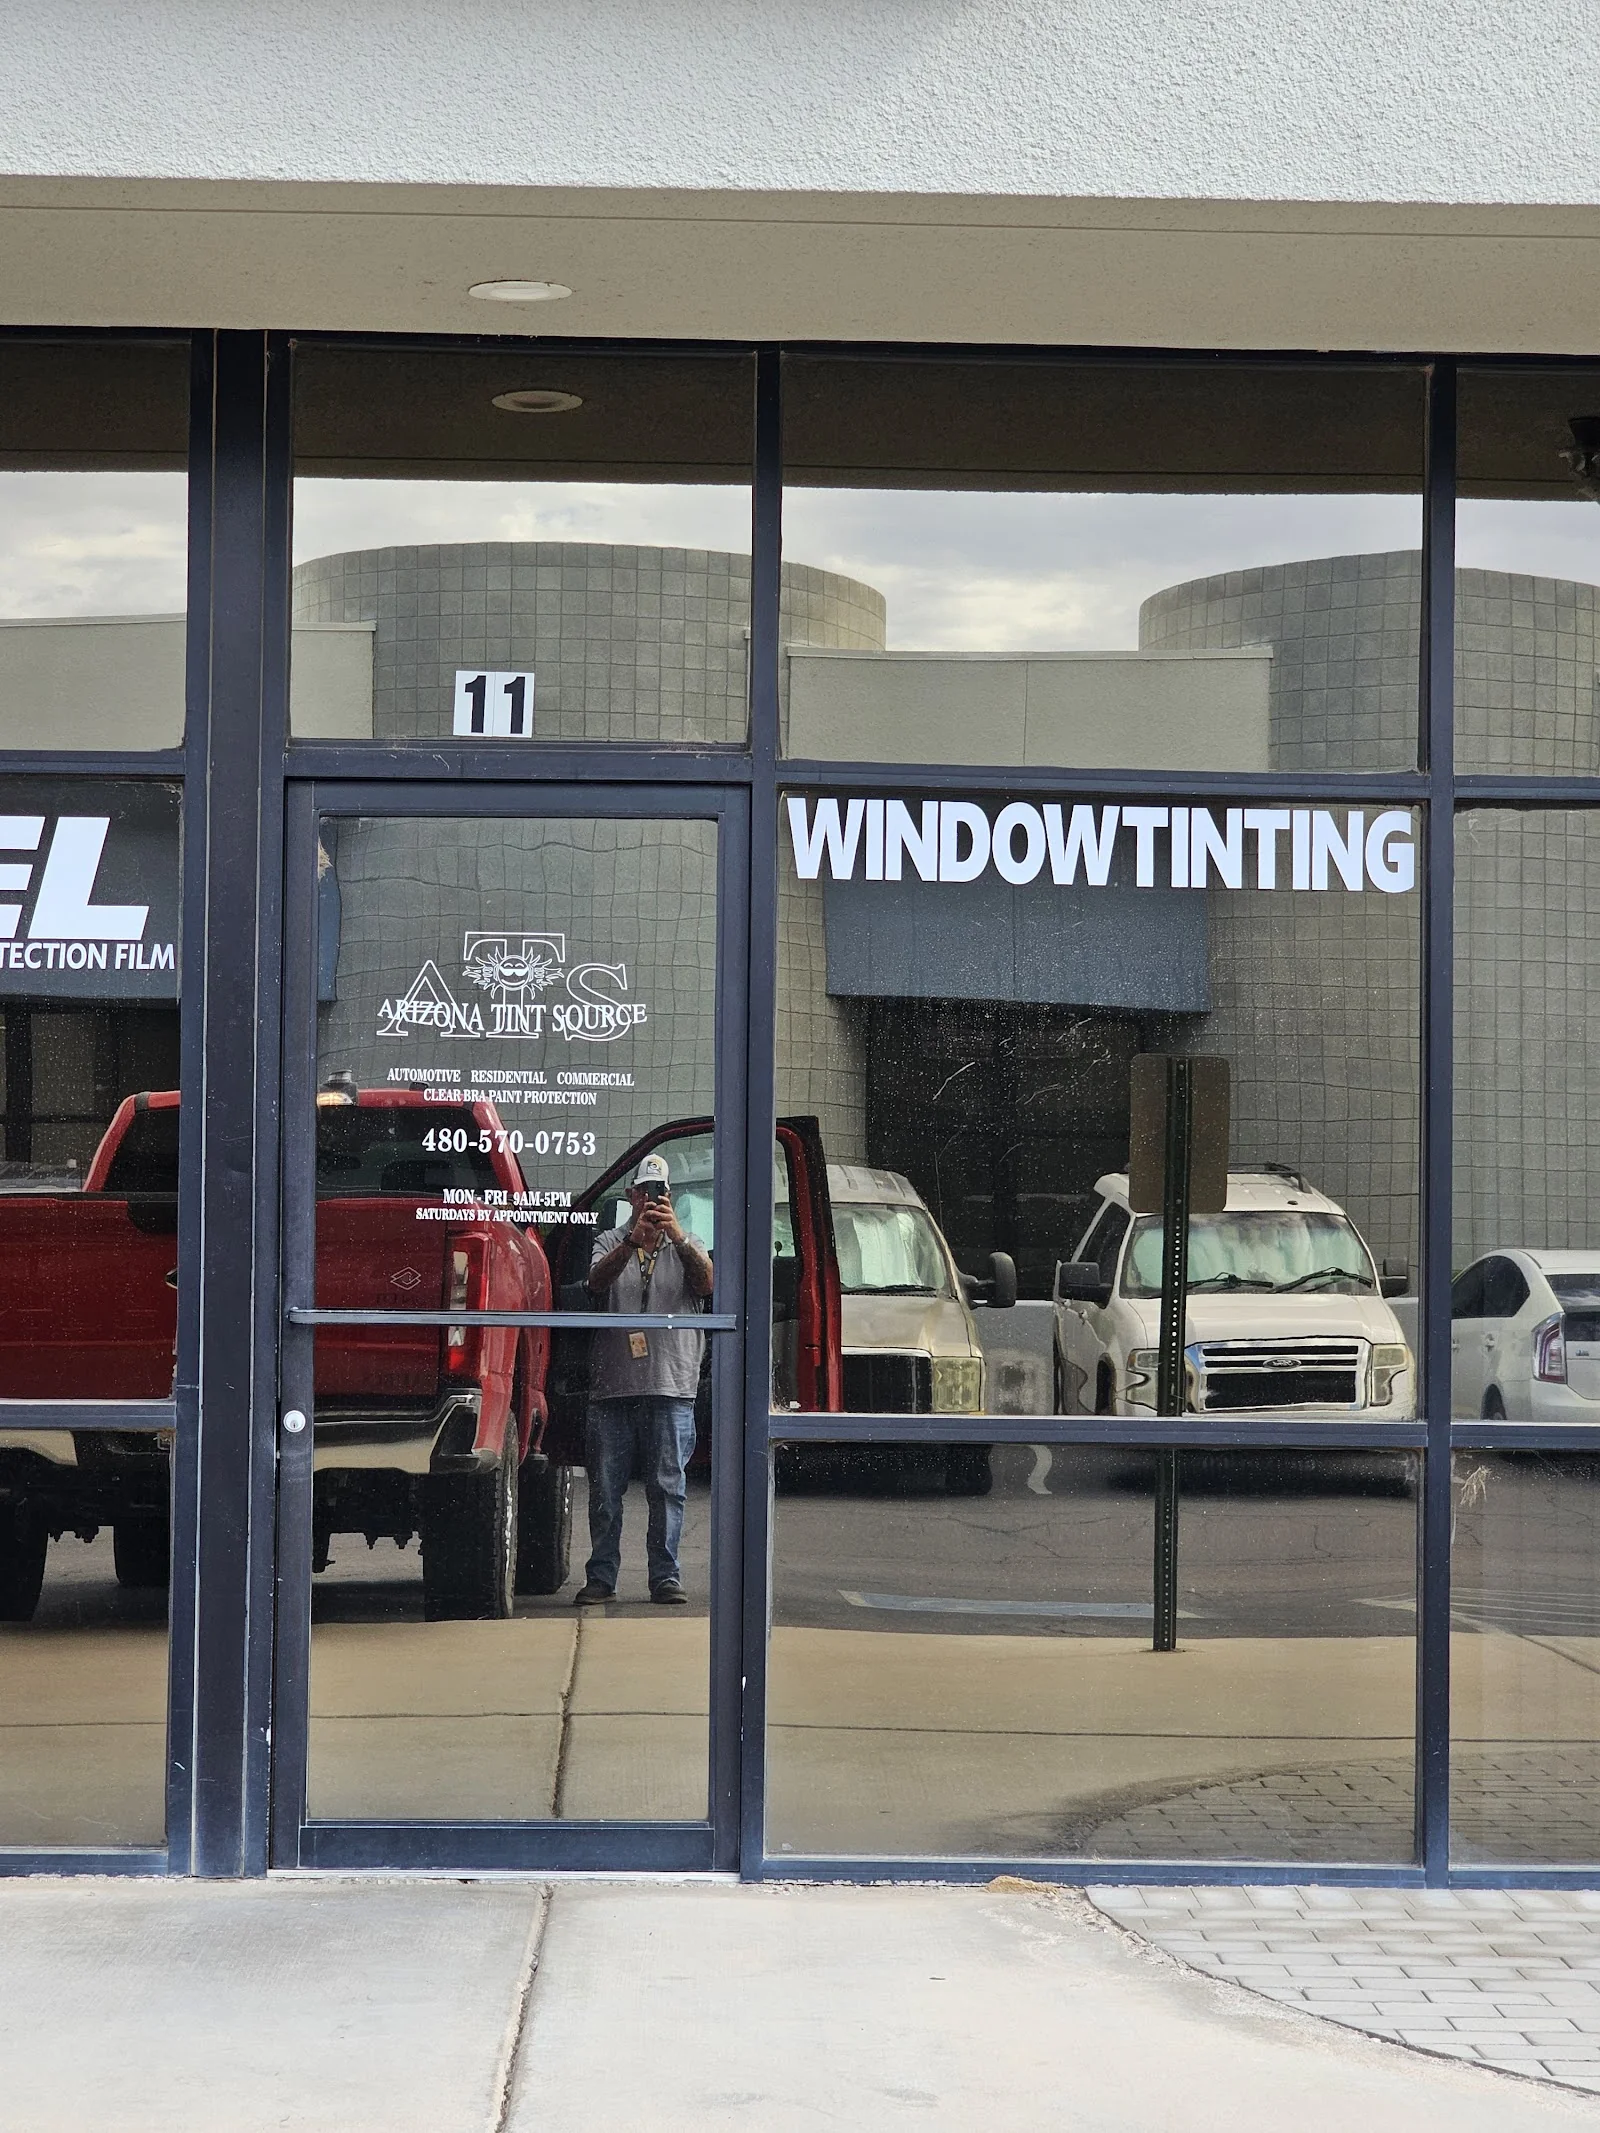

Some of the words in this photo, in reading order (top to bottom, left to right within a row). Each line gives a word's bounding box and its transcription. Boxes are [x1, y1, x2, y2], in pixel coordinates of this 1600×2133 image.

[464, 675, 526, 734] 11
[0, 942, 108, 969] TECTION
[114, 943, 175, 970] FILM
[376, 998, 485, 1031] ARIZONA
[490, 1004, 547, 1033] TINT
[551, 1003, 648, 1032] SOURCE
[386, 1067, 461, 1083] AUTOMOTIVE
[470, 1069, 548, 1085] RESIDENTIAL
[556, 1071, 635, 1087] COMMERCIAL
[423, 1088, 462, 1102] CLEAR
[463, 1089, 488, 1103] BRA
[489, 1090, 523, 1104] PAINT
[524, 1091, 598, 1106] PROTECTION
[421, 1128, 596, 1156] 480-570-0753
[442, 1188, 475, 1205] MON
[483, 1189, 508, 1206] FRI
[513, 1191, 572, 1208] 9AM-5PM
[415, 1207, 475, 1221] SATURDAYS
[477, 1209, 492, 1222] BY
[493, 1210, 569, 1224] APPOINTMENT
[570, 1211, 599, 1225] ONLY
